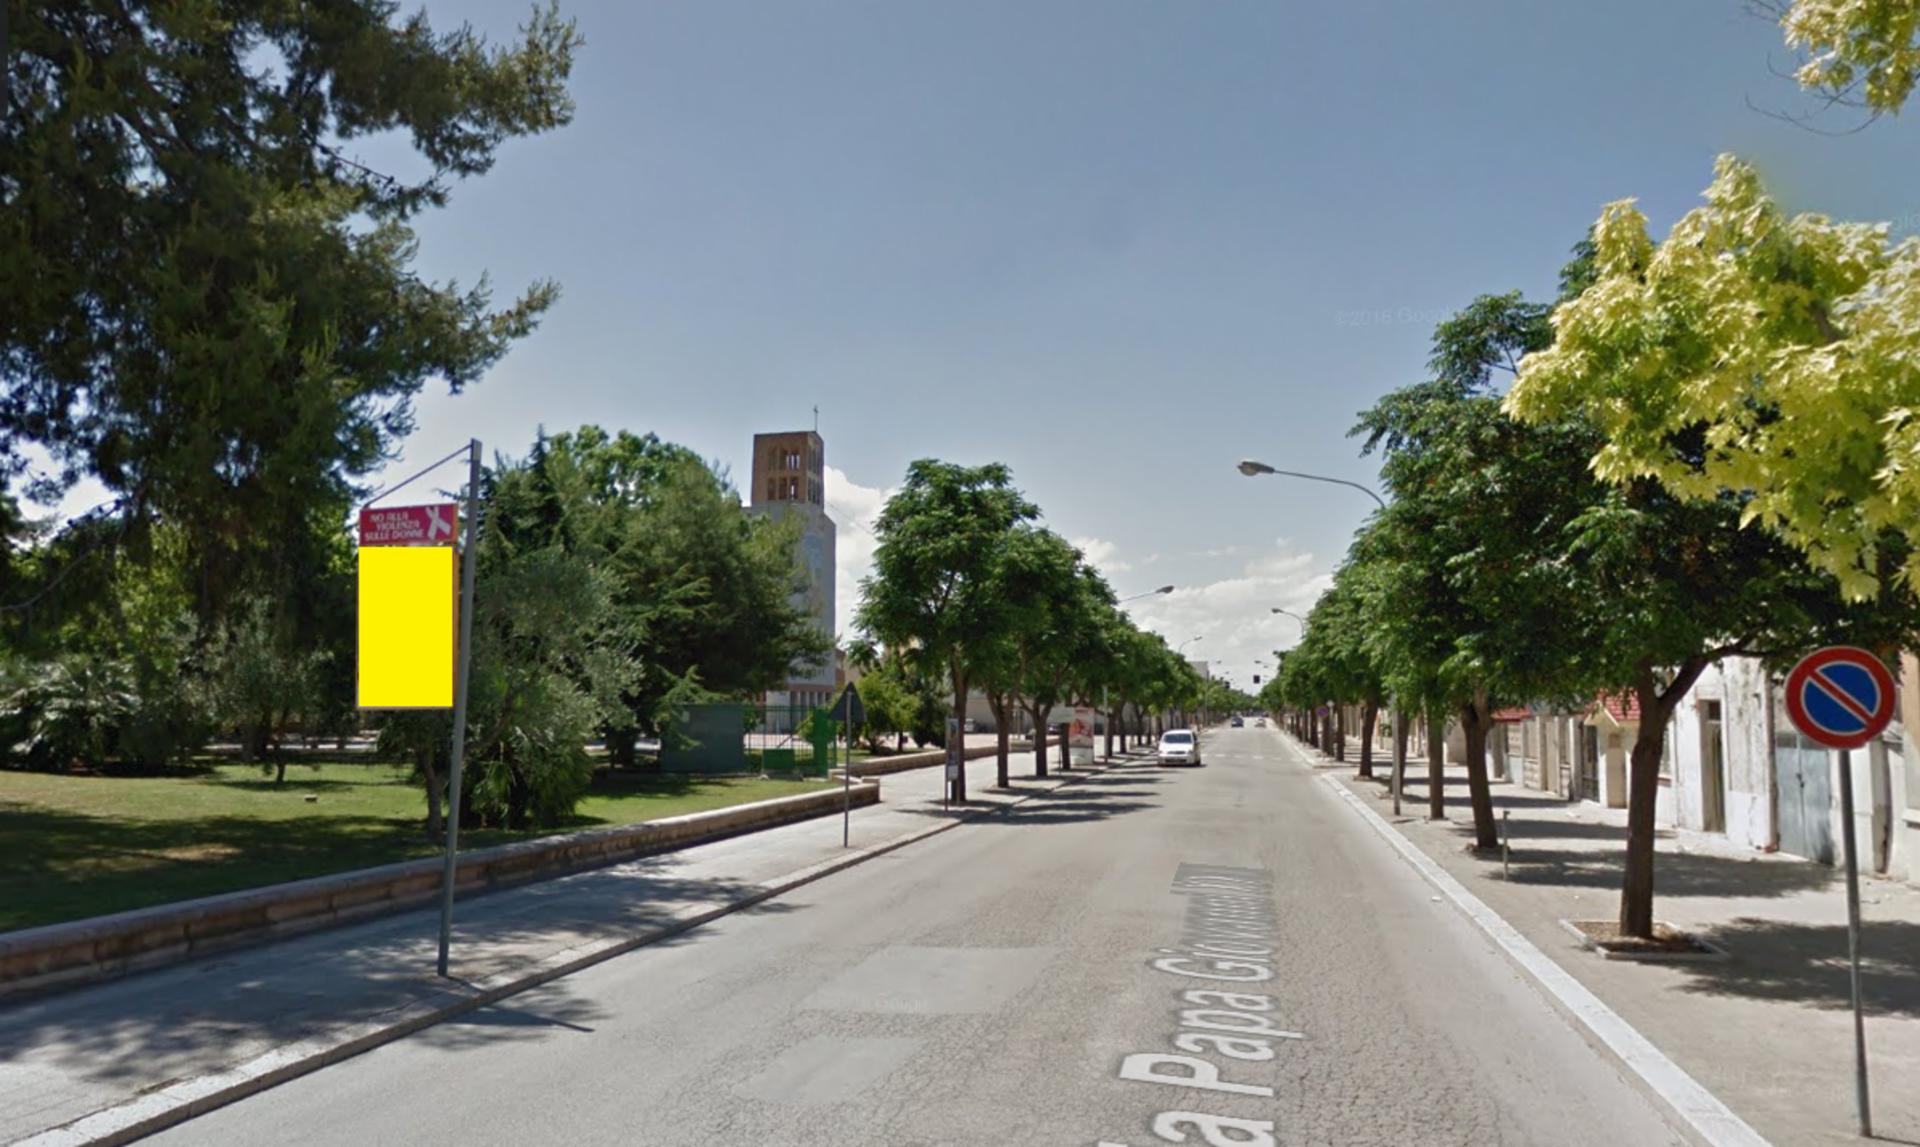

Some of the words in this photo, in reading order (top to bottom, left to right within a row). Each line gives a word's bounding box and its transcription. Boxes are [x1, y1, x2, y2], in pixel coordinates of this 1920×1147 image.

[370, 513, 384, 522] NO
[376, 520, 420, 530] VIOLENZA
[365, 531, 389, 541] SULLE
[392, 529, 424, 539] DONNE
